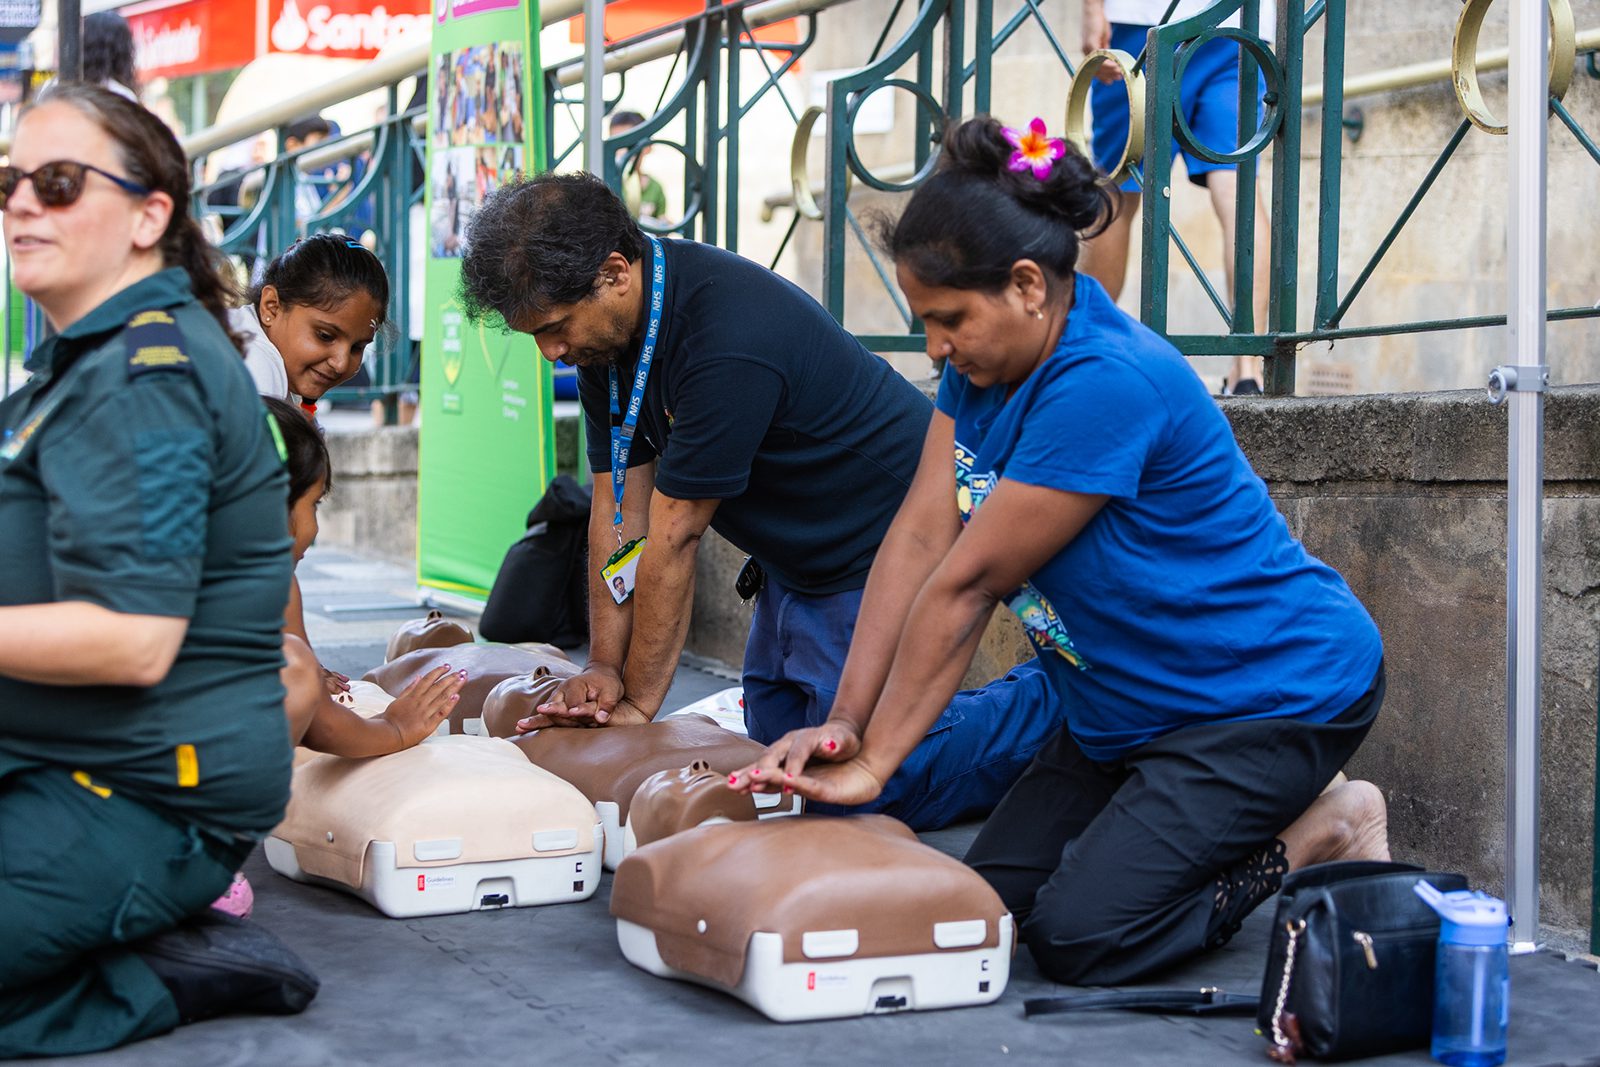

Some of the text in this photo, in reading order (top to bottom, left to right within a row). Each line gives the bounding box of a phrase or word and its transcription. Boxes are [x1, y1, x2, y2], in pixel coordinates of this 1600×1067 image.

[654, 265, 663, 284] NHS
[653, 291, 662, 311] NHS
[648, 318, 659, 338] NHS
[642, 344, 653, 365] NHS
[636, 370, 647, 391] NHS
[629, 395, 640, 417] NHS
[616, 448, 628, 484] NHS NHS
